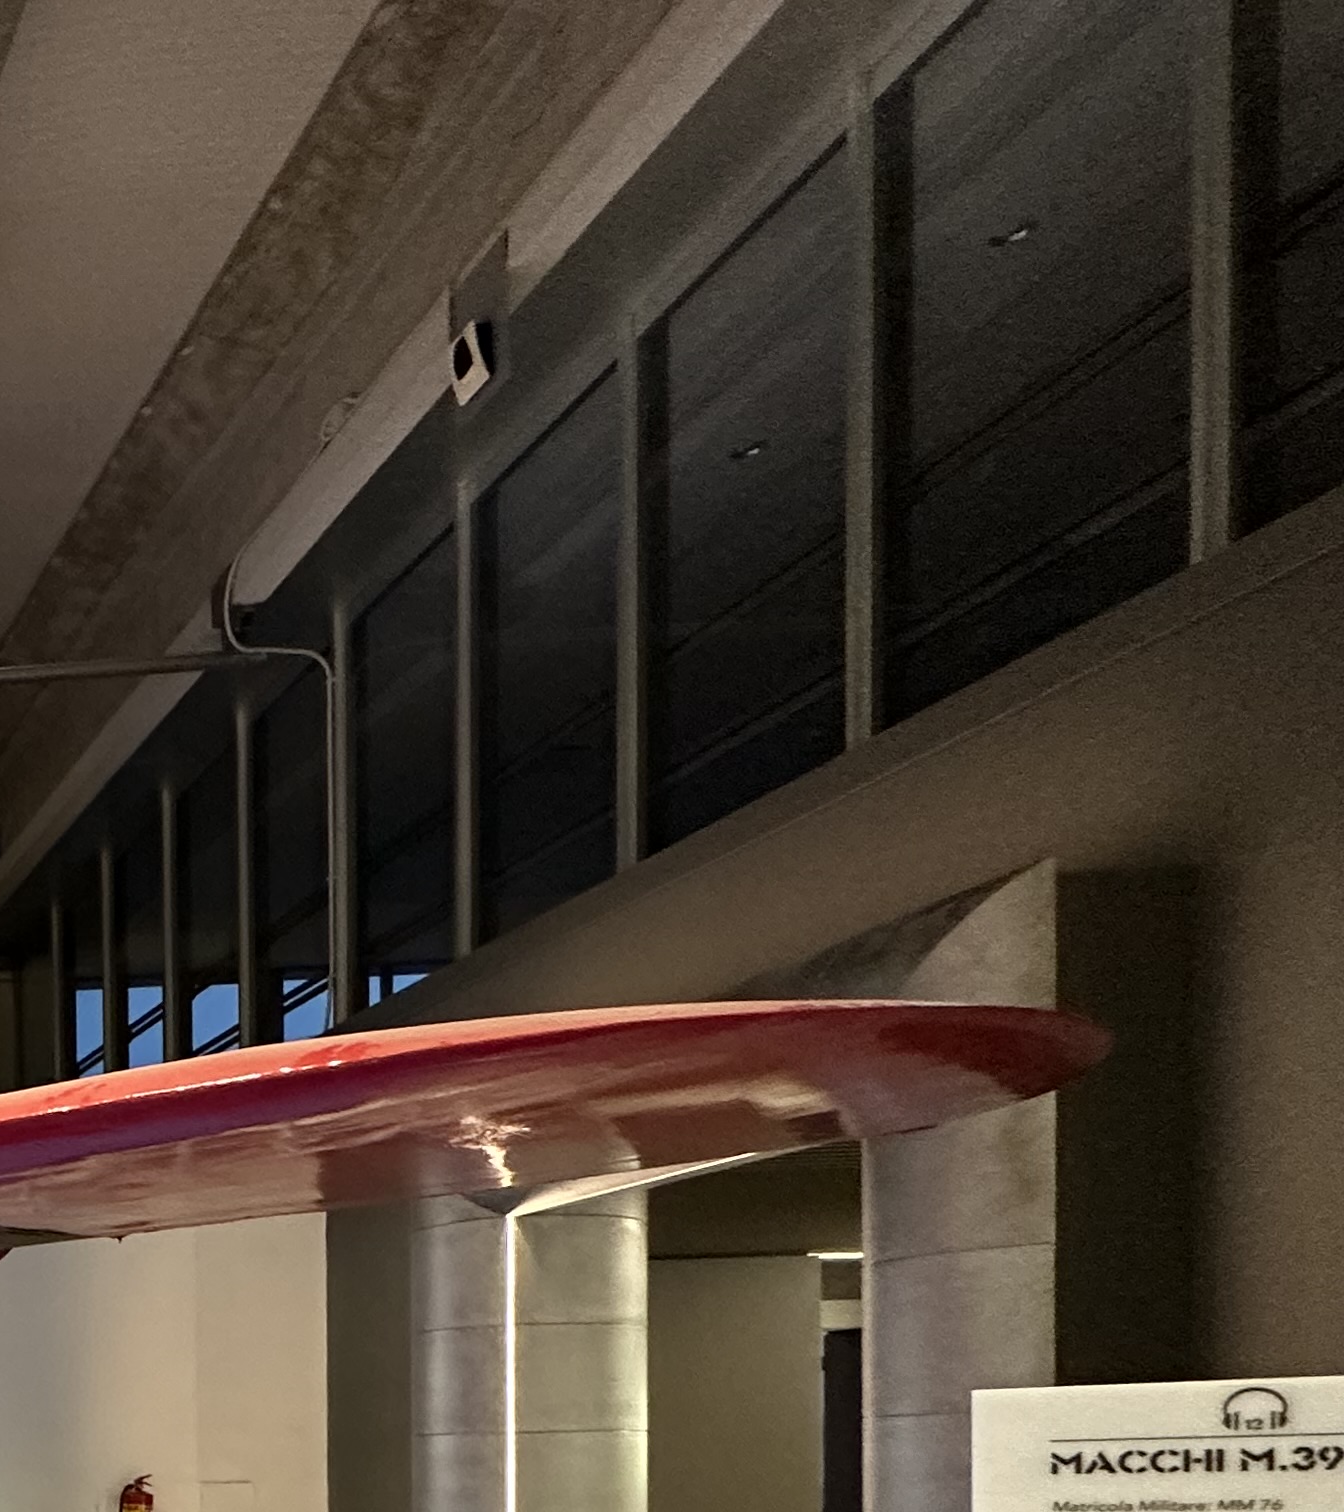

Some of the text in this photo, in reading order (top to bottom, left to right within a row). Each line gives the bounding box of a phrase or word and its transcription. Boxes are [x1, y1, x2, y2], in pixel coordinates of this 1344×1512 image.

[1050, 1446, 1344, 1475] MACCHI M.39
[1052, 1500, 1134, 1512] Matricola
[1260, 1498, 1285, 1511] 76
